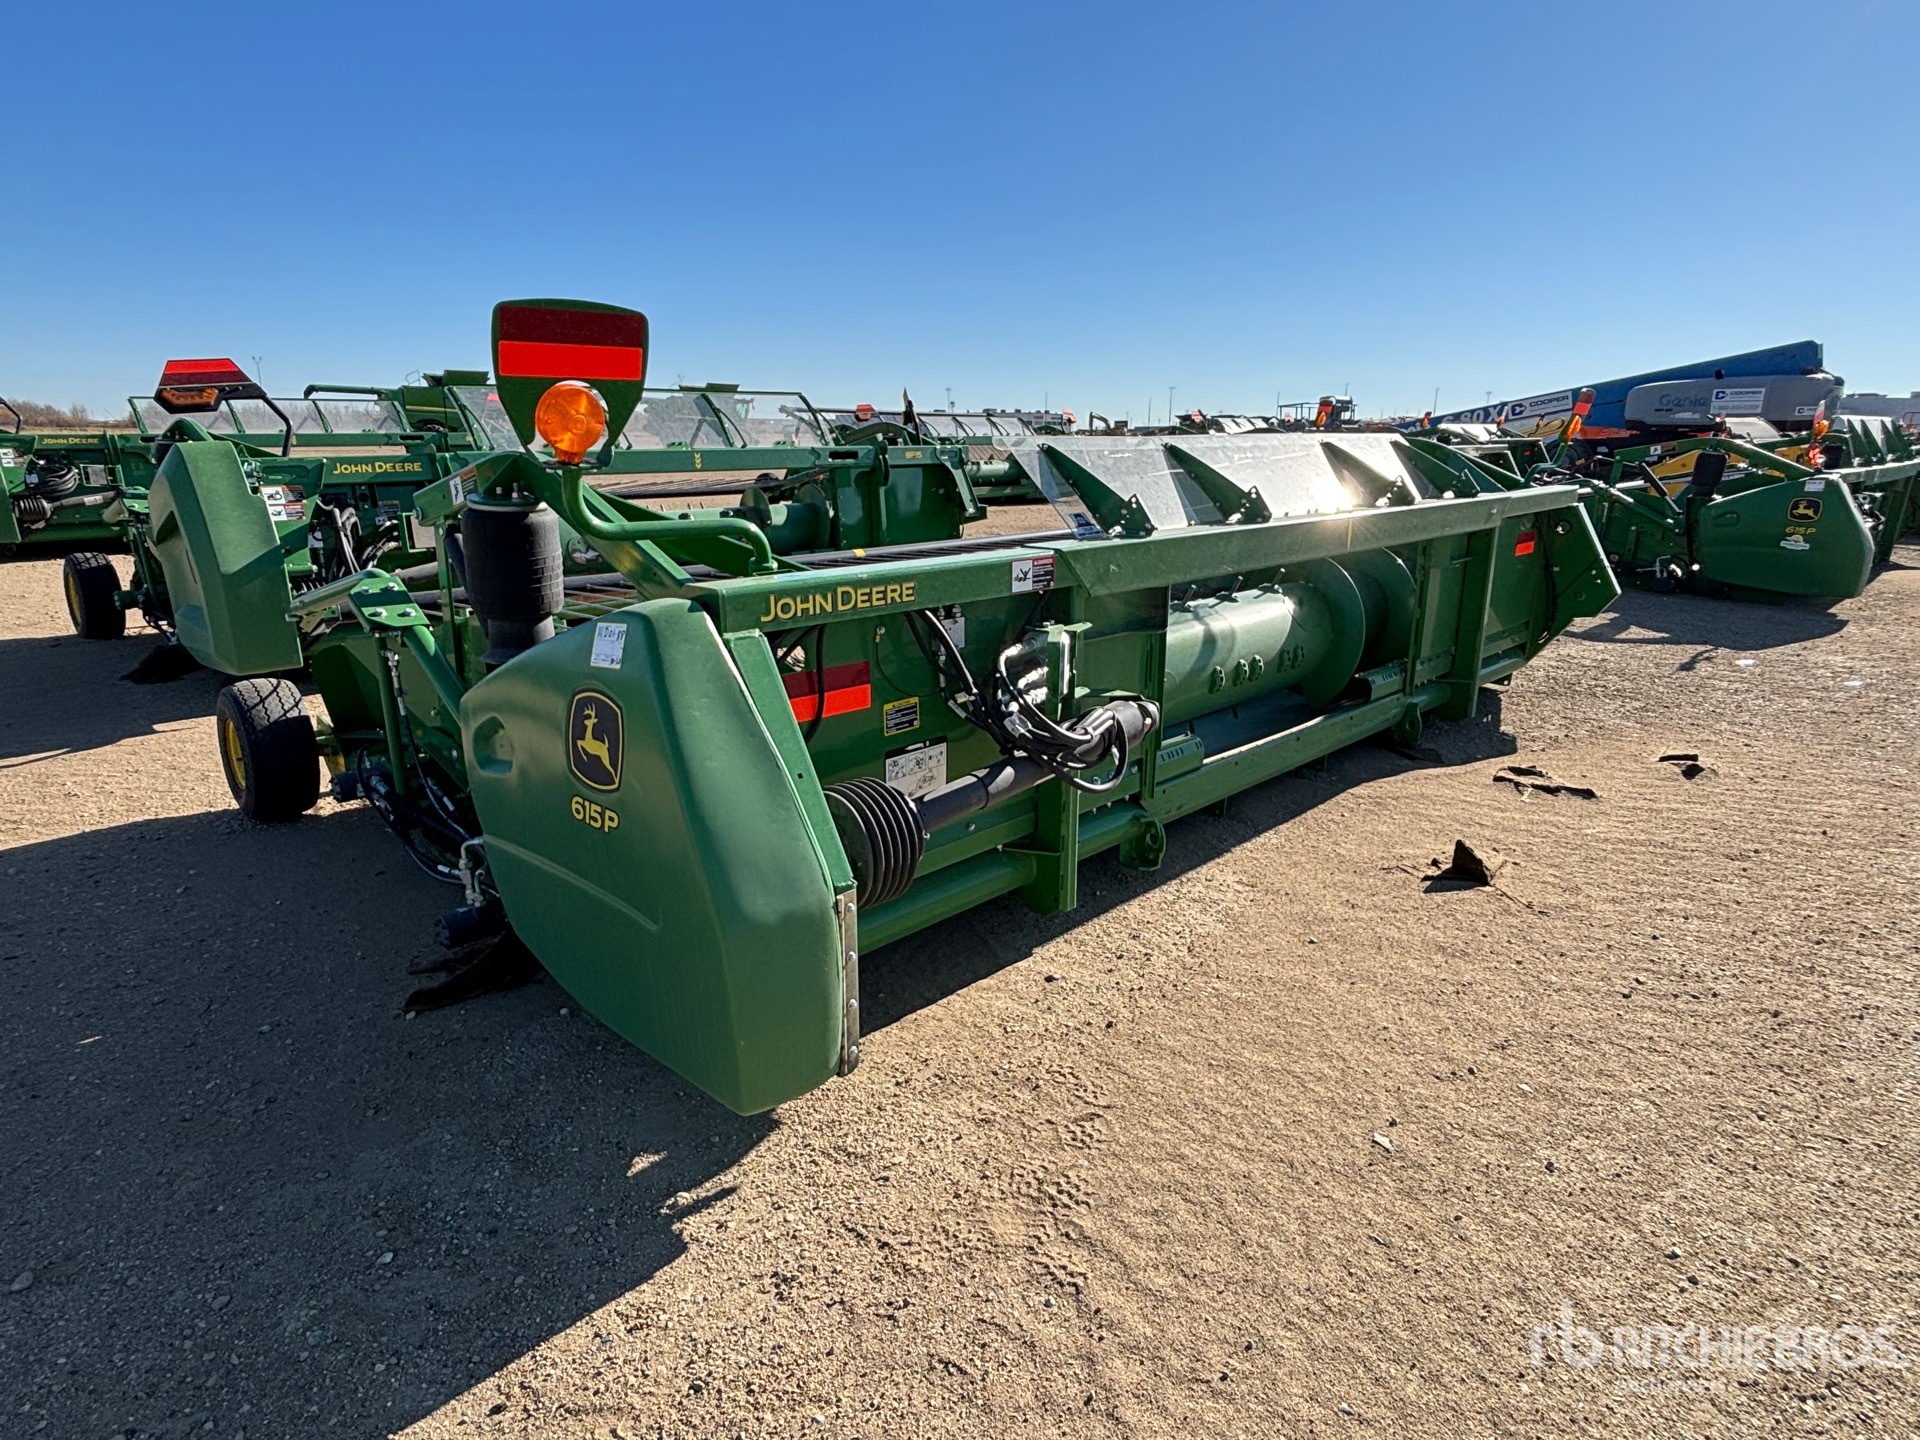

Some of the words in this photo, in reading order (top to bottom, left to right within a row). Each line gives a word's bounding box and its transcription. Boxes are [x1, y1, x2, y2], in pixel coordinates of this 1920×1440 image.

[1529, 395, 1569, 408] COOPER
[1659, 394, 1707, 408] Genie
[333, 462, 372, 474] JOHN
[375, 462, 422, 473] DEERE
[1785, 526, 1816, 534] 615P
[761, 592, 833, 622] JOHN
[836, 582, 916, 611] DEERE
[571, 796, 619, 833] 615P
